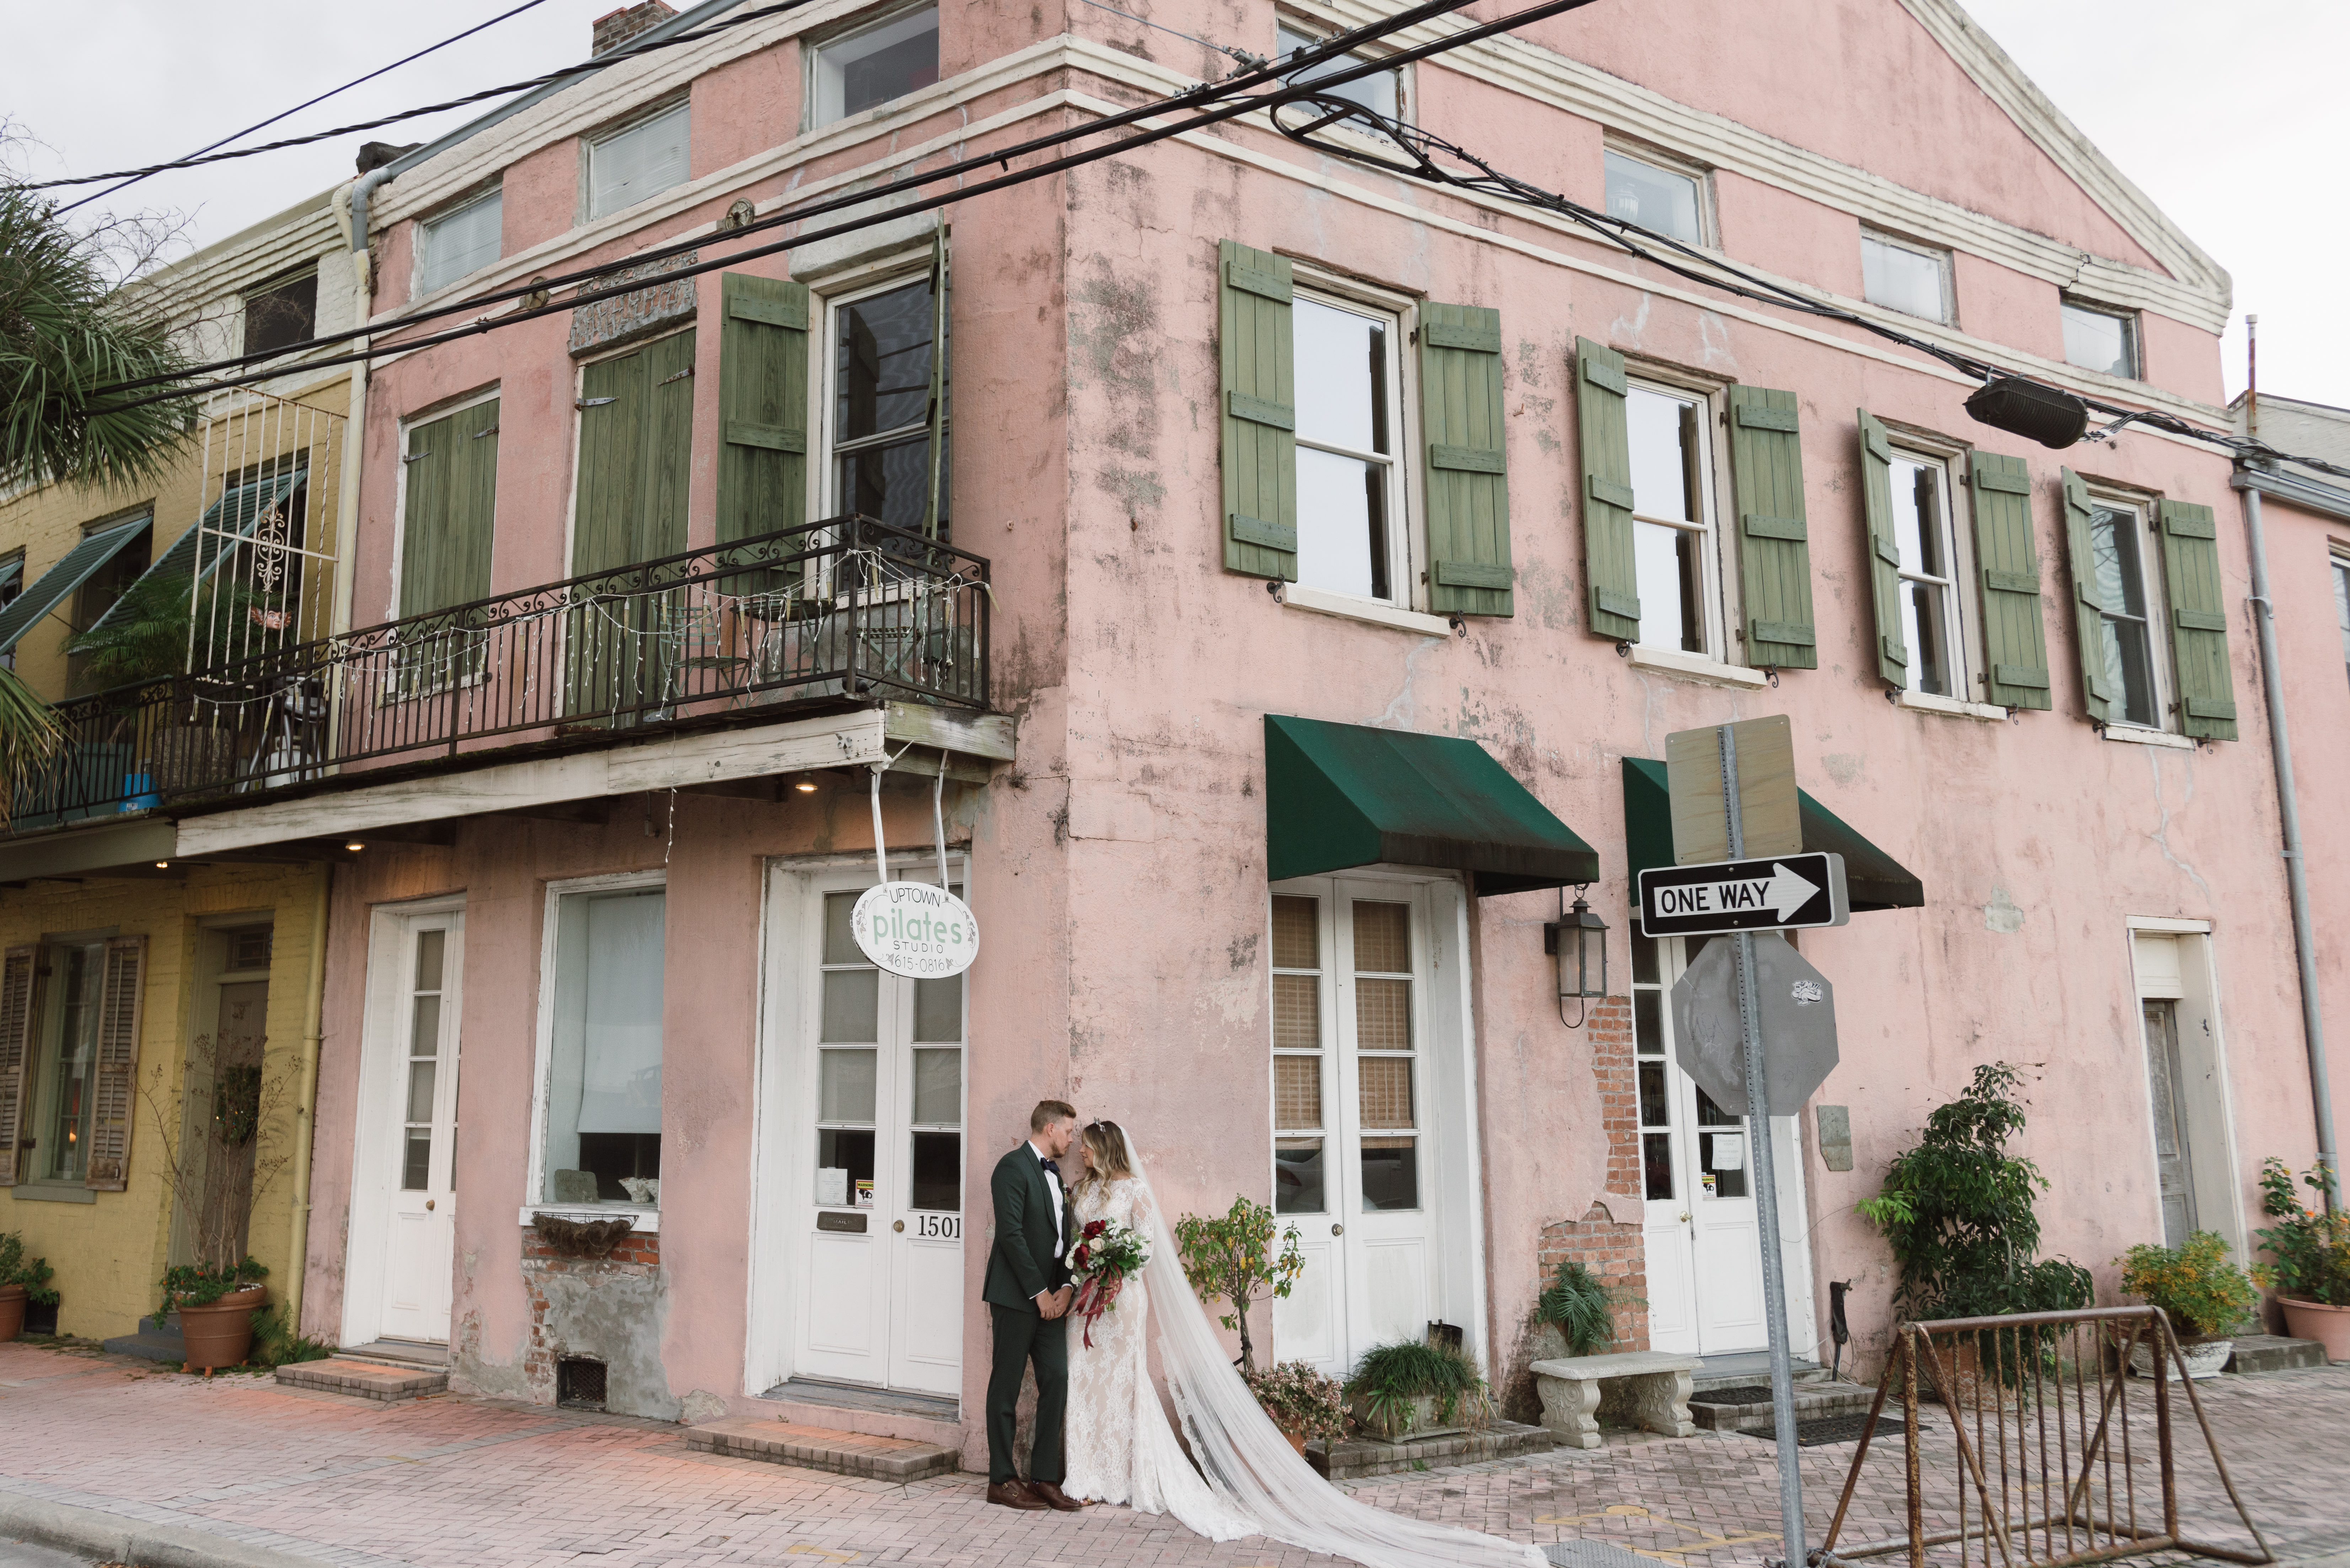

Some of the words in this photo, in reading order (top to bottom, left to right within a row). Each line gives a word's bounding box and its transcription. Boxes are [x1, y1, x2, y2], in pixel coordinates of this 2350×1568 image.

[889, 888, 940, 907] UPTOWN
[1661, 886, 1710, 914] ONE
[1718, 881, 1770, 909] WAY
[873, 908, 962, 945] pilates
[893, 940, 943, 954] STUDIO
[895, 954, 945, 972] 615-0816
[918, 1215, 960, 1238] 1501
